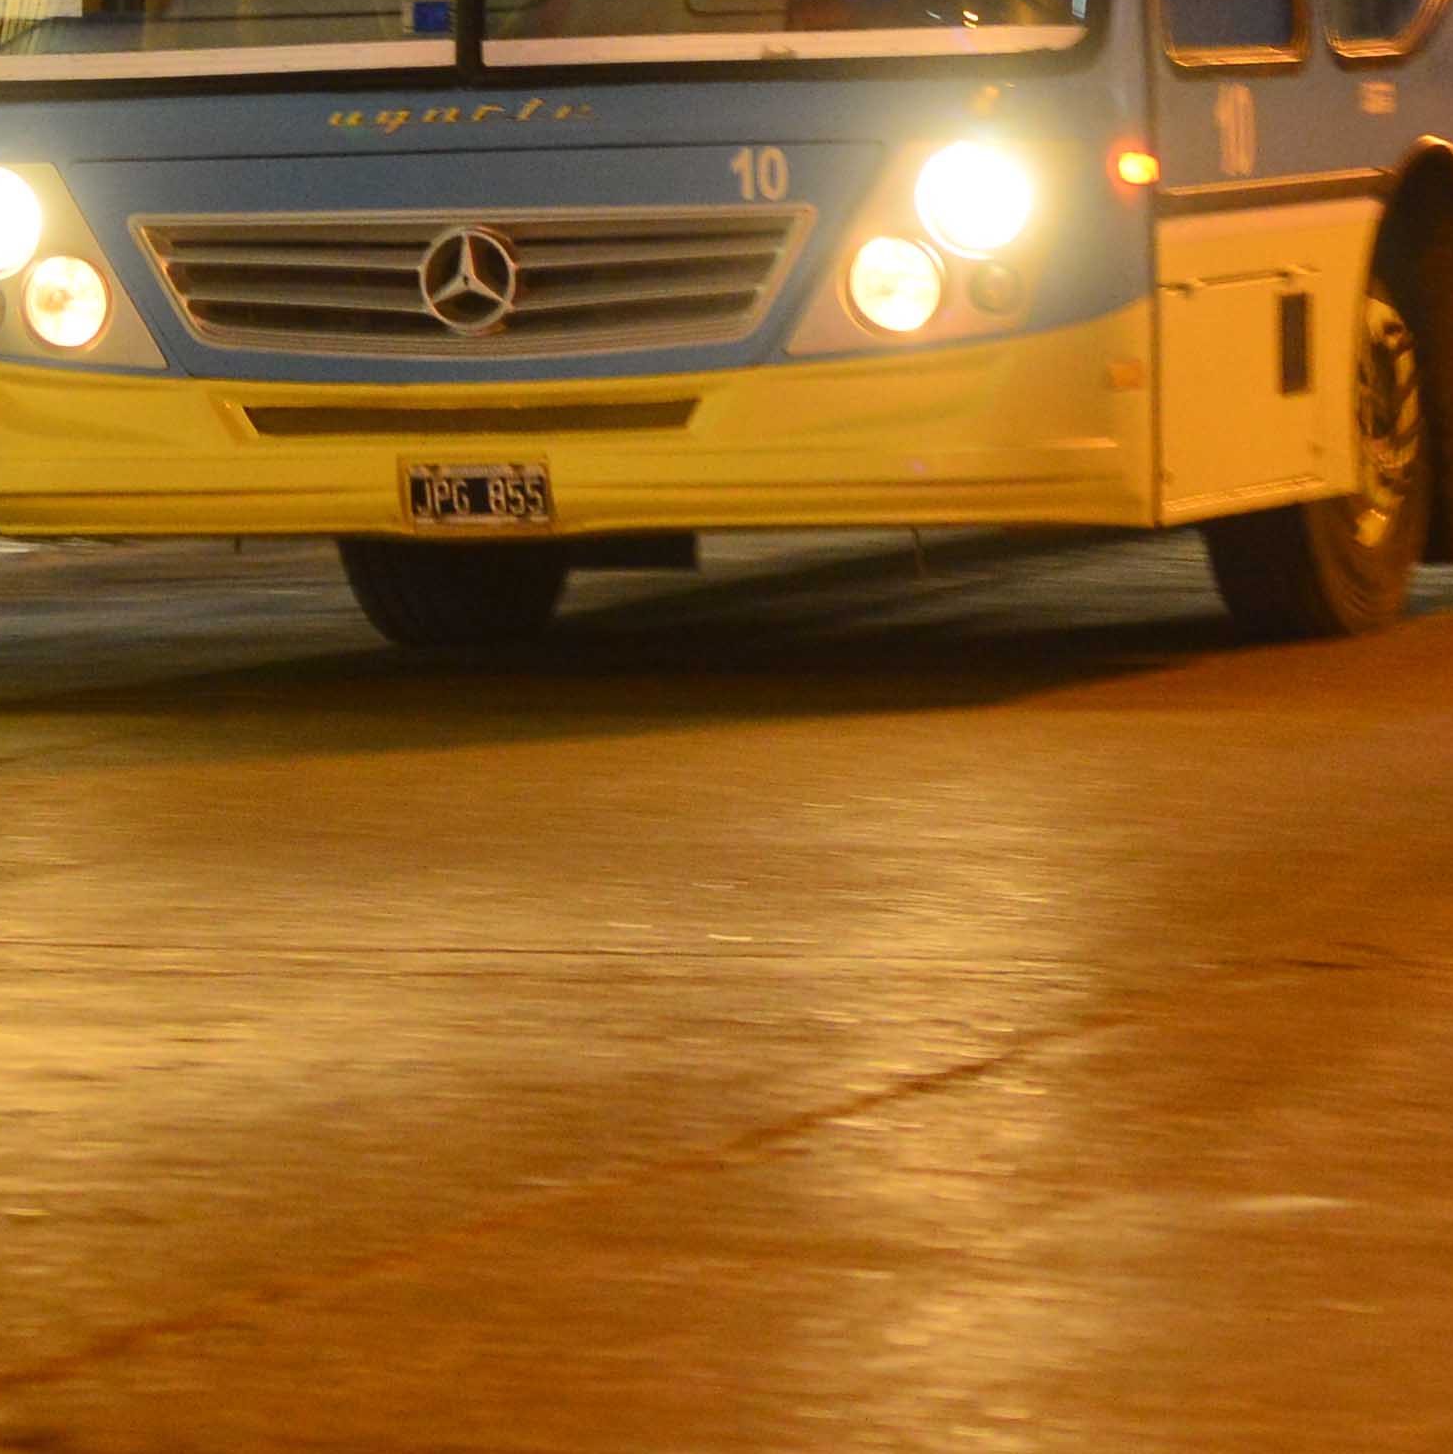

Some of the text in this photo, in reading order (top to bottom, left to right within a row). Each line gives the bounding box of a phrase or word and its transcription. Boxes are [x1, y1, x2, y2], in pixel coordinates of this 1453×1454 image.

[730, 146, 790, 201] 10
[414, 476, 545, 516] JPG 855
